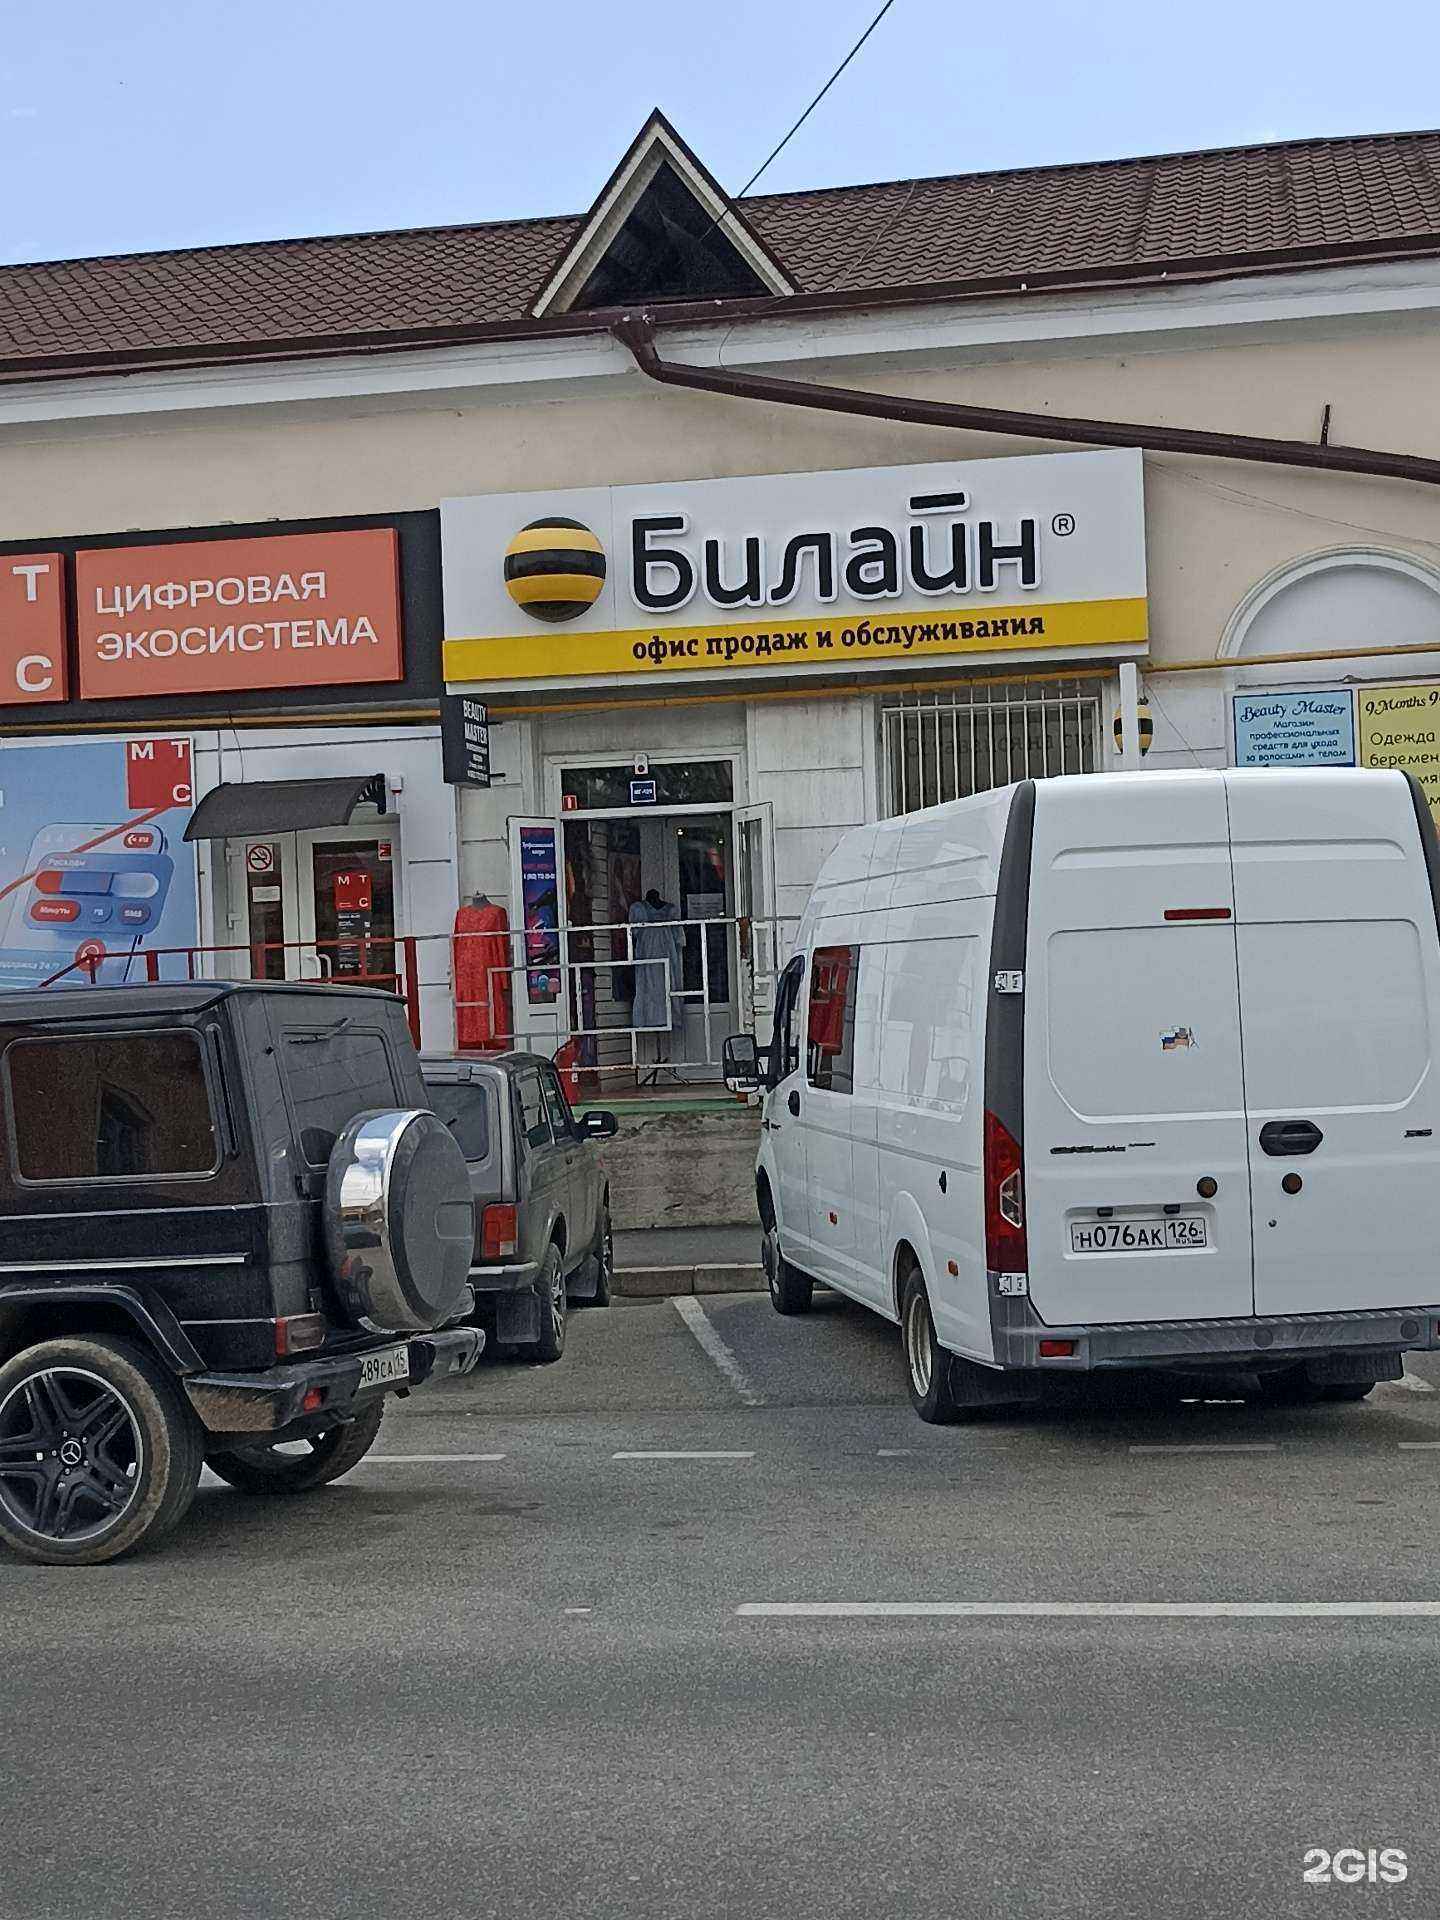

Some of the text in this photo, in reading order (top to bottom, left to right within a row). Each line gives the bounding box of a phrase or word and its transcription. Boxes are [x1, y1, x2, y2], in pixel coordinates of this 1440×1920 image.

[632, 491, 1039, 608] Билайн
[96, 571, 326, 617] ЦИФРОВАЯ
[96, 616, 378, 661] ЭКОСИСТЕМА
[633, 616, 1045, 664] офис продаж и обслуживания
[462, 699, 486, 723] BEAUTY
[1240, 701, 1346, 723] Beauty Master
[1375, 696, 1426, 715] Months
[464, 722, 488, 745] MASTER
[1273, 720, 1315, 728] Магазин
[1249, 729, 1340, 741] профессиональных
[1370, 731, 1435, 746] Одежда
[131, 741, 189, 761] М Т
[1252, 740, 1338, 753] средств для ухода
[1259, 753, 1305, 762] волосами
[1318, 750, 1347, 759] телом
[337, 874, 368, 886] М Т
[1079, 1222, 1199, 1248] Н076АК 126
[395, 1350, 405, 1368] 15
